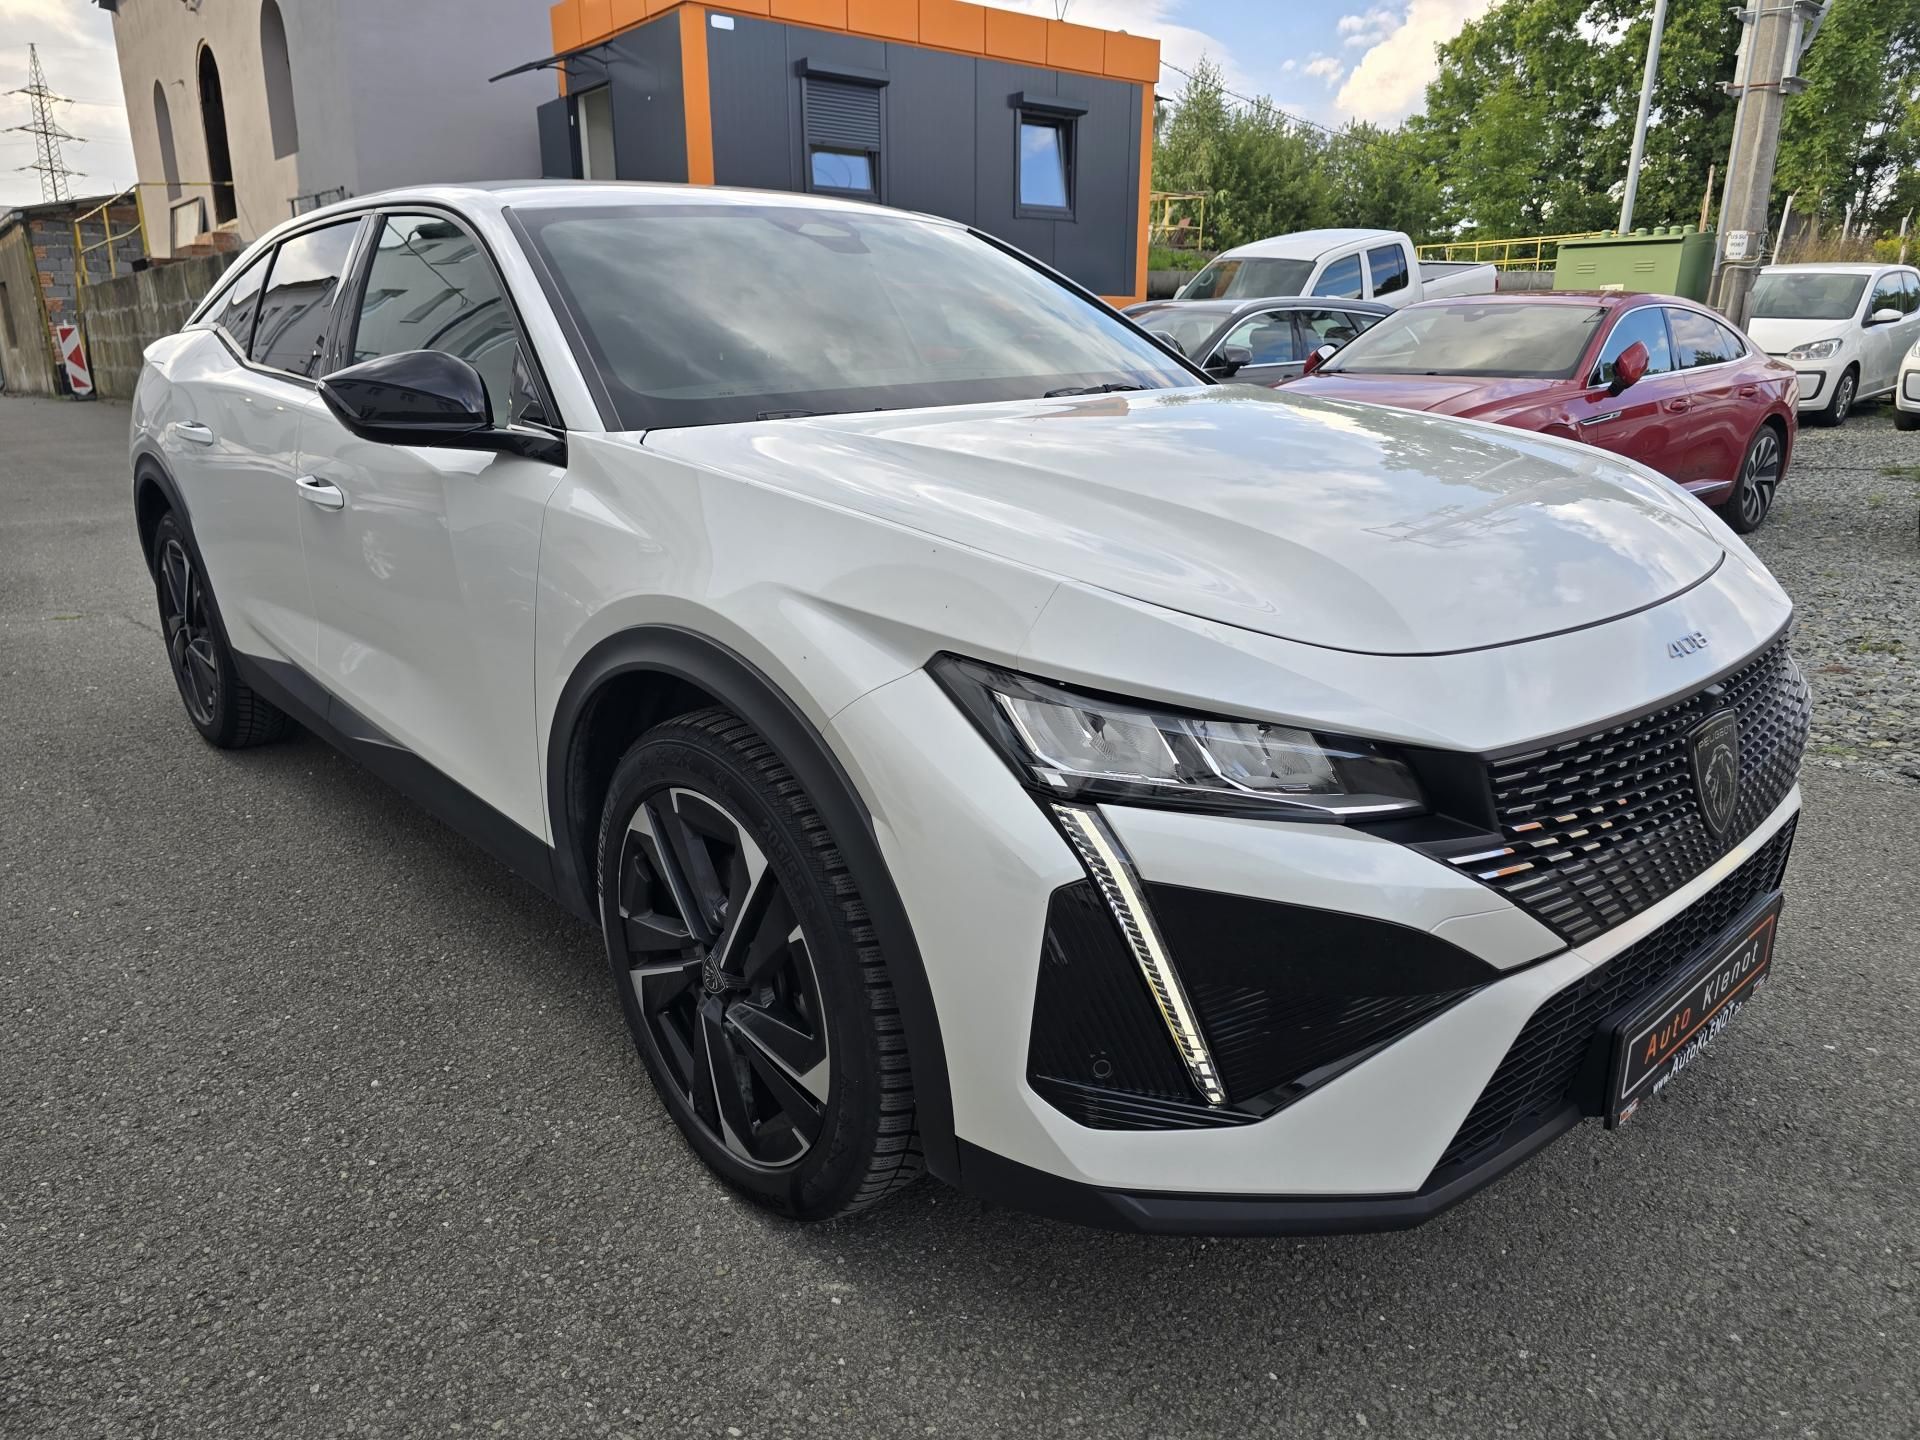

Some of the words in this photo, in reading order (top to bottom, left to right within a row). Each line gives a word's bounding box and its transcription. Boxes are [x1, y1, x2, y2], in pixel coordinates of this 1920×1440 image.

[1667, 631, 1709, 659] 408
[1697, 724, 1733, 752] PEUGEOT
[1645, 1007, 1691, 1065] Auto
[1702, 940, 1759, 1011] Klenot
